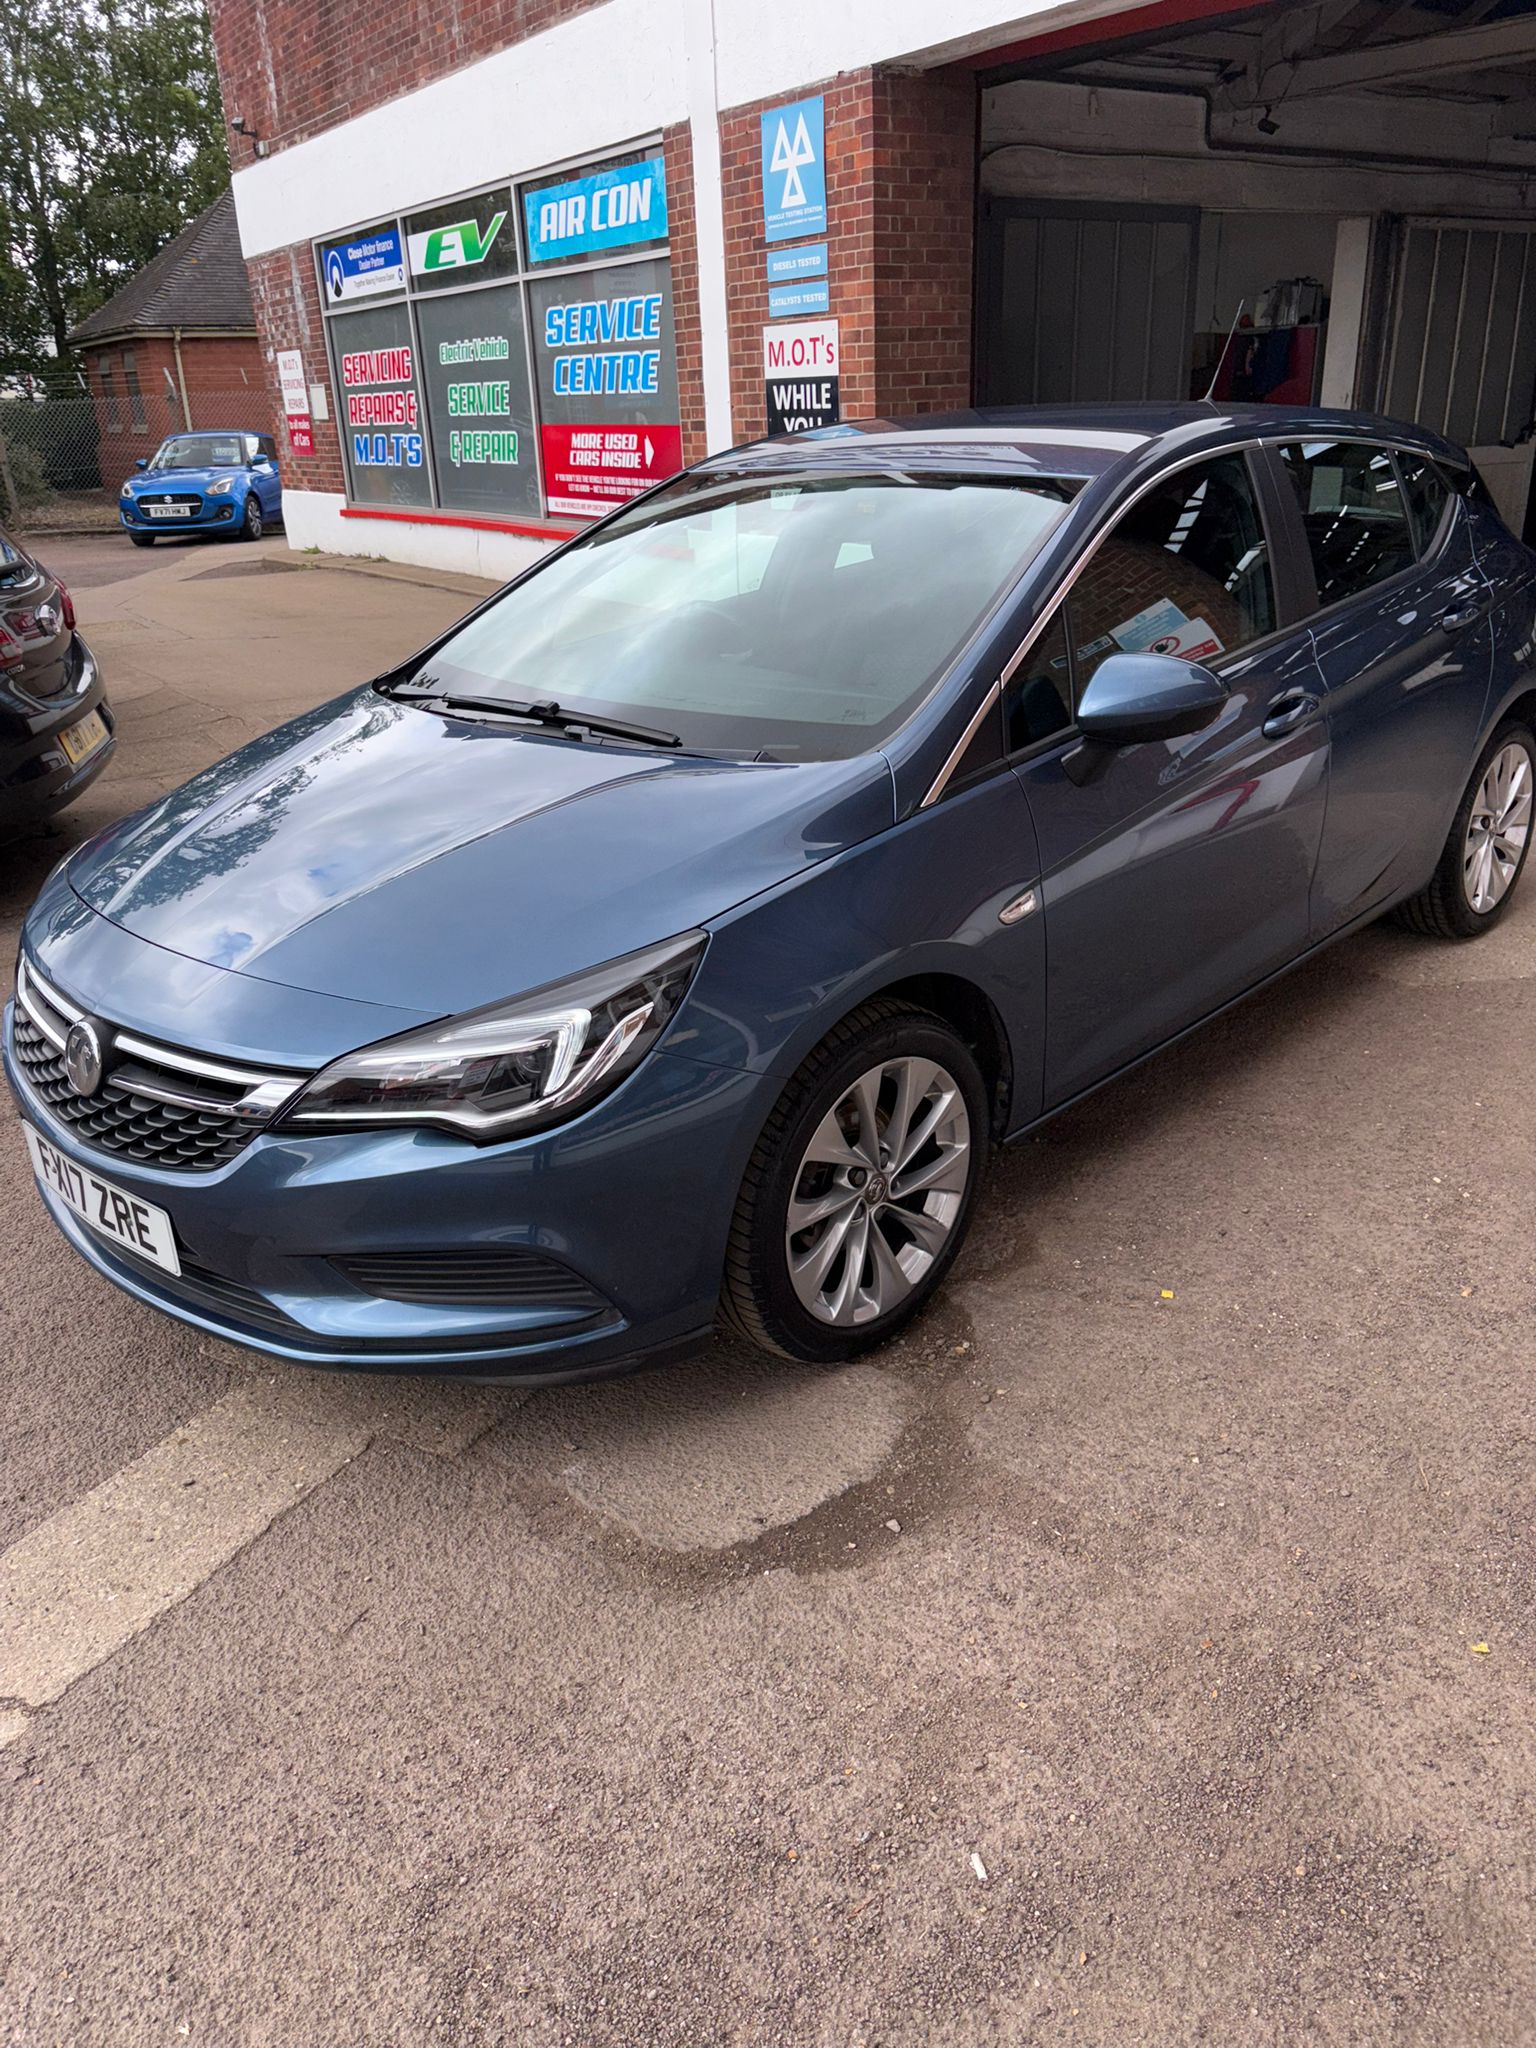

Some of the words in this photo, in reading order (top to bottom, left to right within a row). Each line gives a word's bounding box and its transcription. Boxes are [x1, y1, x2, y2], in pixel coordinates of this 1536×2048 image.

[540, 194, 585, 243] AIR
[591, 178, 652, 231] CON
[424, 211, 508, 270] EV
[772, 259, 797, 272] DIESELS
[798, 255, 821, 267] TESTED
[770, 294, 801, 307] CATALYSTS
[802, 292, 826, 304] TESTED
[546, 294, 663, 347] SERVICE
[342, 347, 412, 386] SERVICING
[440, 340, 474, 365] Electric
[474, 336, 509, 361] Vehicle
[768, 334, 835, 367] M.O.T's
[554, 350, 660, 396] CENTRE
[349, 393, 404, 426] REPAIRS
[405, 391, 418, 429] &
[448, 381, 510, 416] SERVICE
[772, 383, 832, 410] WHILE
[354, 434, 423, 467] M.O.T'S
[450, 431, 462, 467] &
[462, 432, 518, 464] REPAIR
[571, 432, 604, 450] MORE
[604, 433, 638, 450] USED
[569, 450, 600, 466] CARS
[601, 451, 642, 469] INSIDE
[36, 1136, 87, 1214] FX17
[90, 1180, 158, 1256] ZRE
